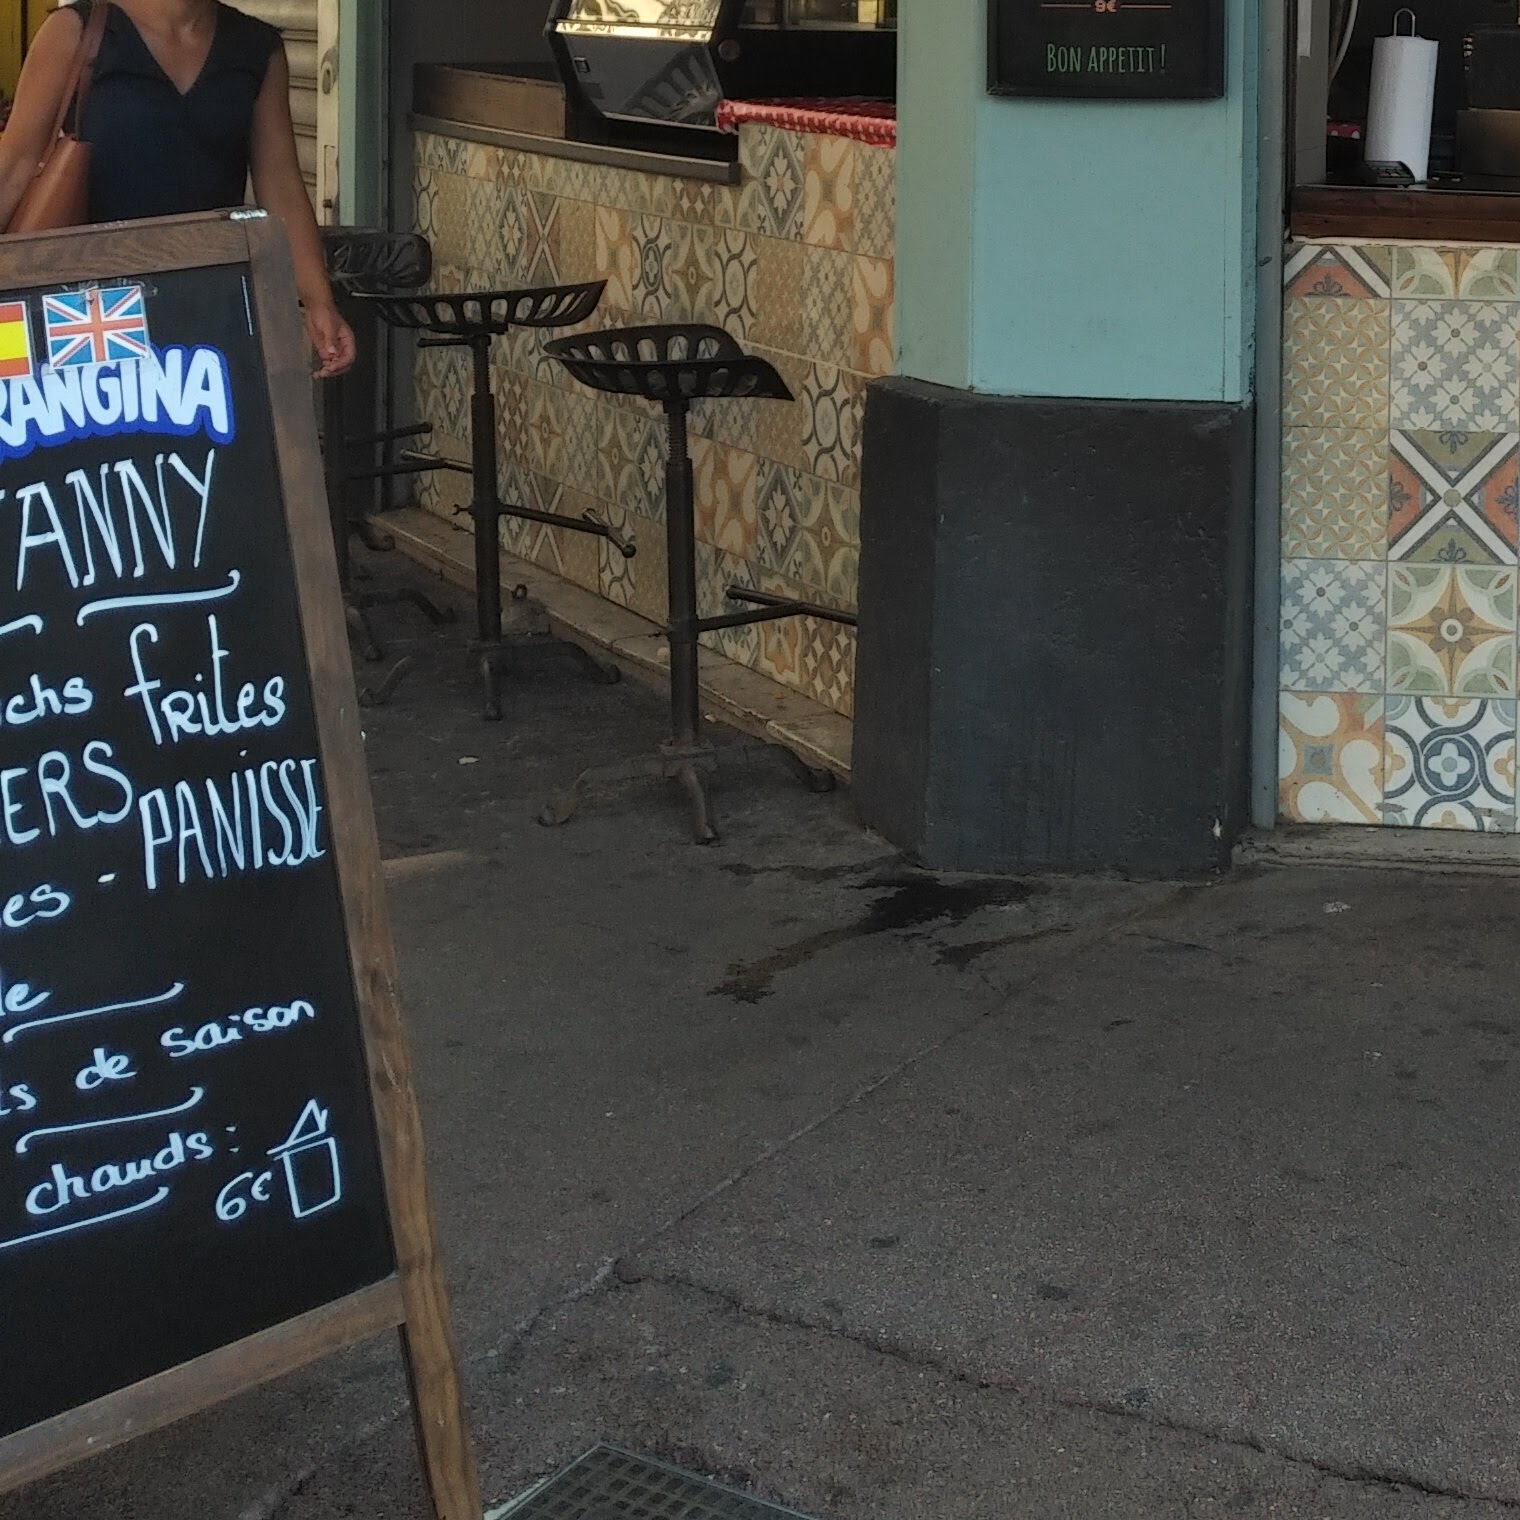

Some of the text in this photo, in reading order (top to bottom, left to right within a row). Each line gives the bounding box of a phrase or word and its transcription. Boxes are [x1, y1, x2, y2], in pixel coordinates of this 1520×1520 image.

[1095, 0, 1117, 13] 9€
[1047, 44, 1156, 73] BON APPETIT
[0, 448, 215, 592] ANNY
[75, 1000, 315, 1090] de saison
[25, 1132, 214, 1215] chauds
[215, 1171, 273, 1221] 6€
